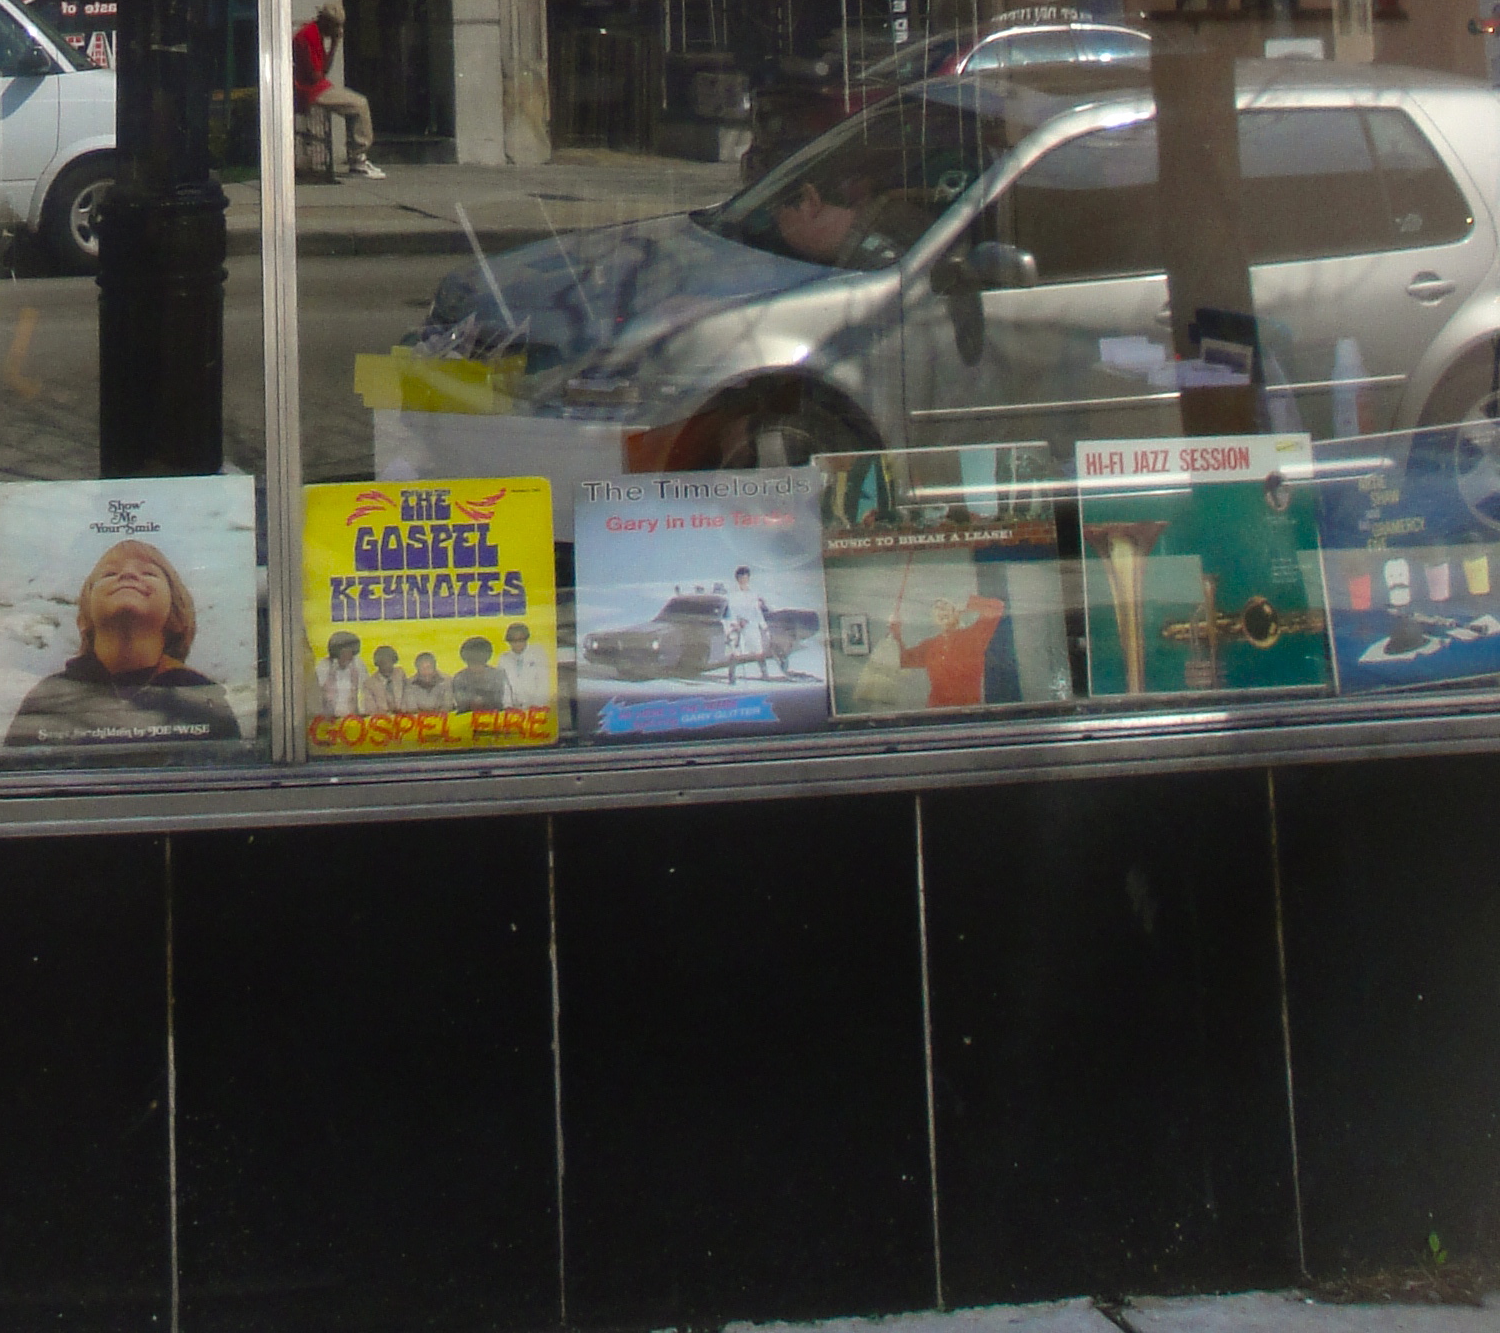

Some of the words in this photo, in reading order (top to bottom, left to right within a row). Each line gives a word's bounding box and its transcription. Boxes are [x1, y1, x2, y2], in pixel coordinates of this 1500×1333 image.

[1085, 451, 1125, 475] HI-FI
[1132, 448, 1170, 473] JAZZ
[1178, 446, 1250, 472] SESSION
[582, 480, 643, 503] The
[652, 474, 812, 501] Timelords
[108, 500, 146, 513] Show
[400, 489, 452, 522] THE
[605, 515, 659, 534] Gary
[665, 514, 685, 530] in
[689, 513, 725, 529] the
[355, 522, 499, 571] GOSPEL
[827, 537, 871, 550] MUSIC
[875, 536, 894, 547] TO
[329, 571, 527, 623] KEYNOTES
[308, 709, 462, 747] GOSPEL
[471, 705, 551, 742] FIRE
